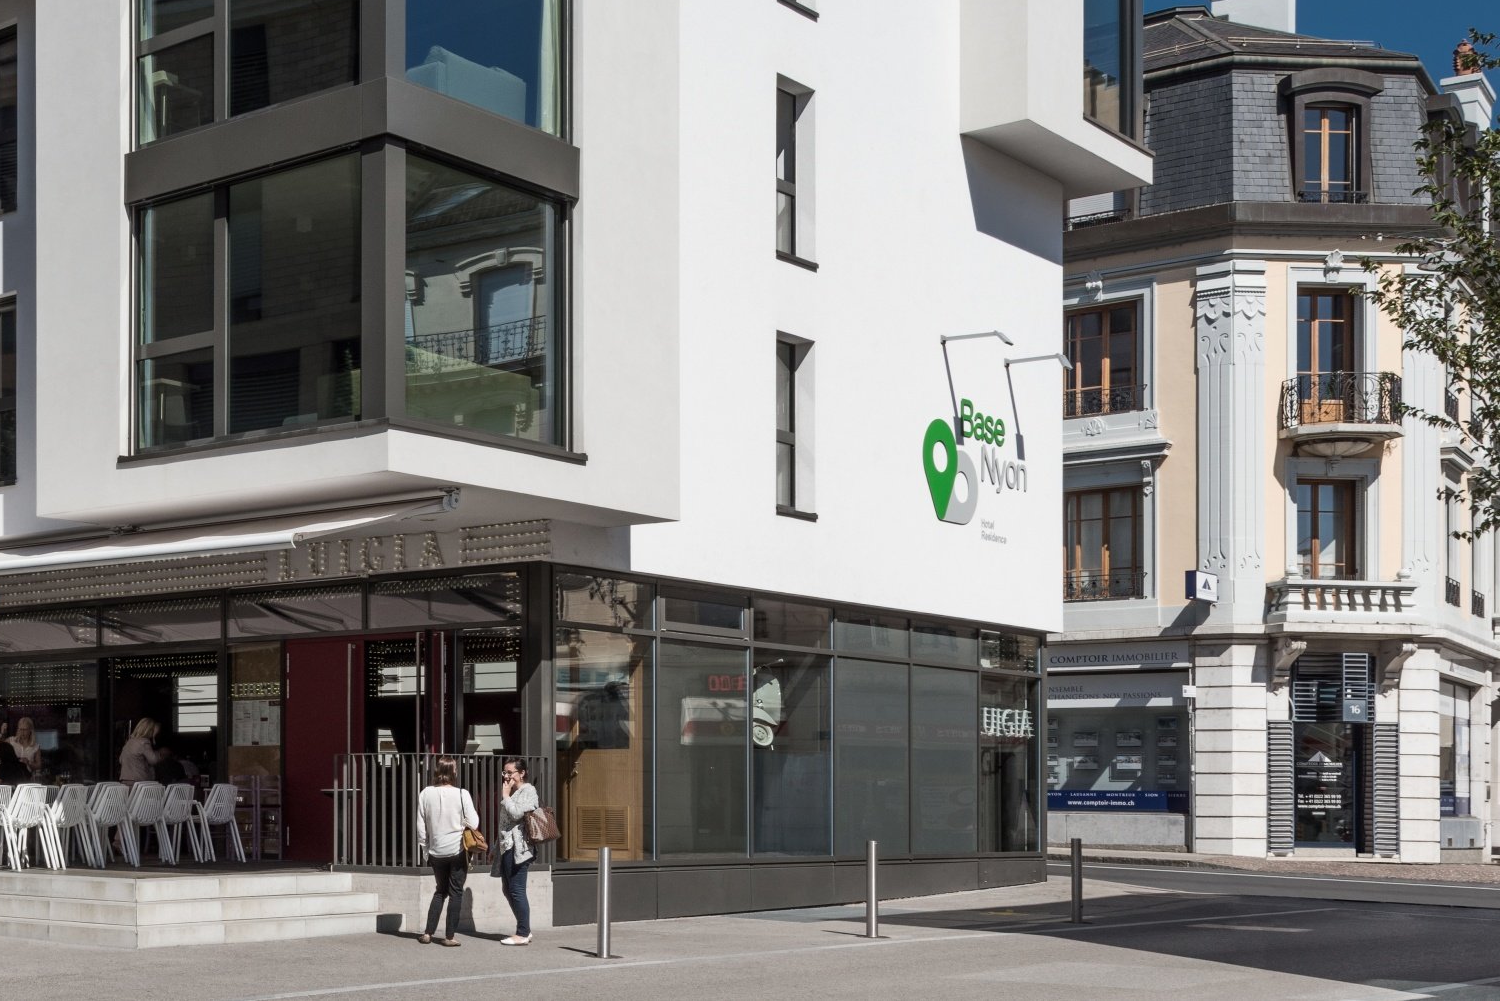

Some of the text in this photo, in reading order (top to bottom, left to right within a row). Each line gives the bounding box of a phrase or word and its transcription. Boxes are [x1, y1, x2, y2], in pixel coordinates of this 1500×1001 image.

[960, 398, 1006, 448] Base
[980, 444, 1028, 495] Nyon
[980, 518, 995, 530] Hotel
[278, 530, 445, 582] LUIGIA
[1050, 651, 1180, 665] COMPTOIR IMMOBILIER
[1123, 691, 1162, 699] PASSIONS
[1349, 704, 1361, 715] 16
